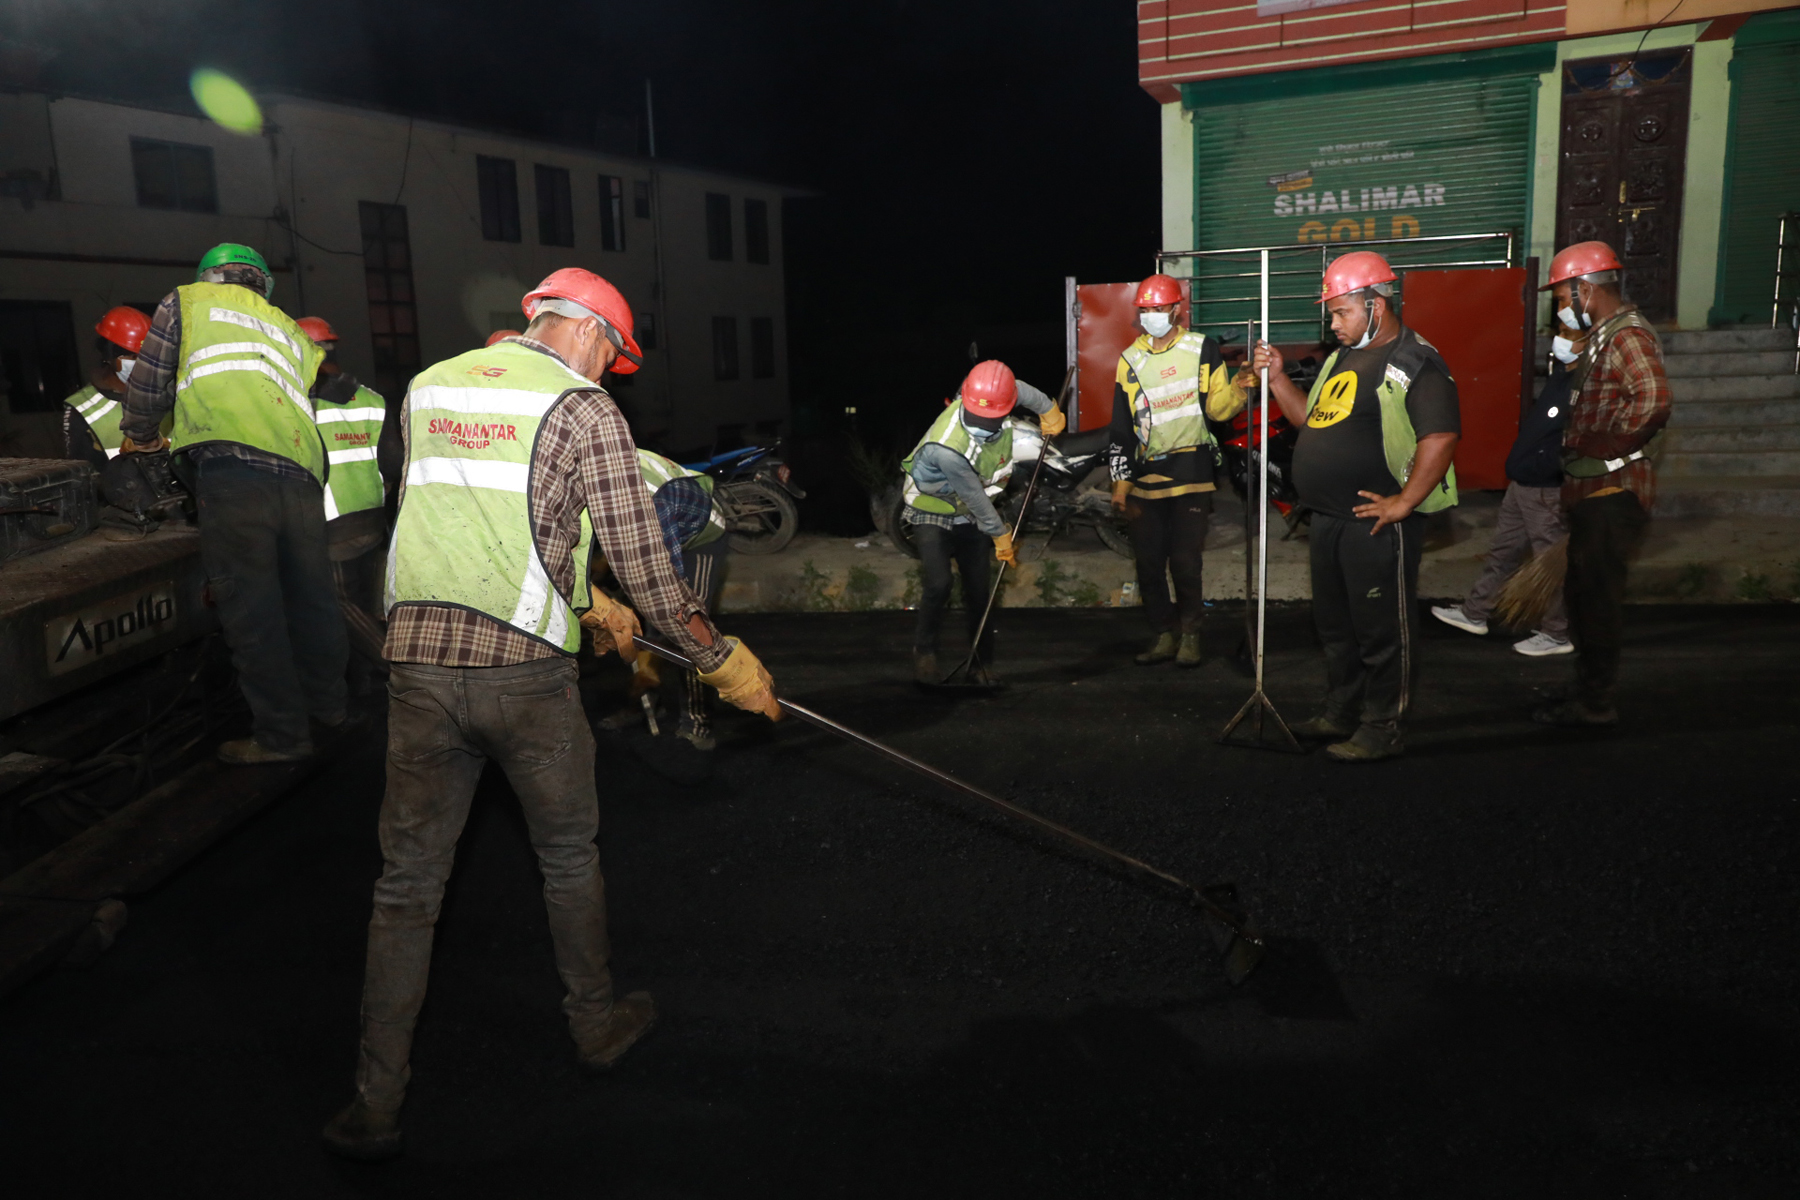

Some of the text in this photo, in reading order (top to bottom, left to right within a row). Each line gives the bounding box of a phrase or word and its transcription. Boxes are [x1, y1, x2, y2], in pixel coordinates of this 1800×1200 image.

[1273, 183, 1446, 217] SHALIMAR
[1297, 215, 1421, 244] GOLD
[1160, 366, 1177, 379] SG
[428, 418, 517, 441] SAMANANTAR
[450, 436, 490, 450] GROUP
[54, 593, 173, 663] Apollo
